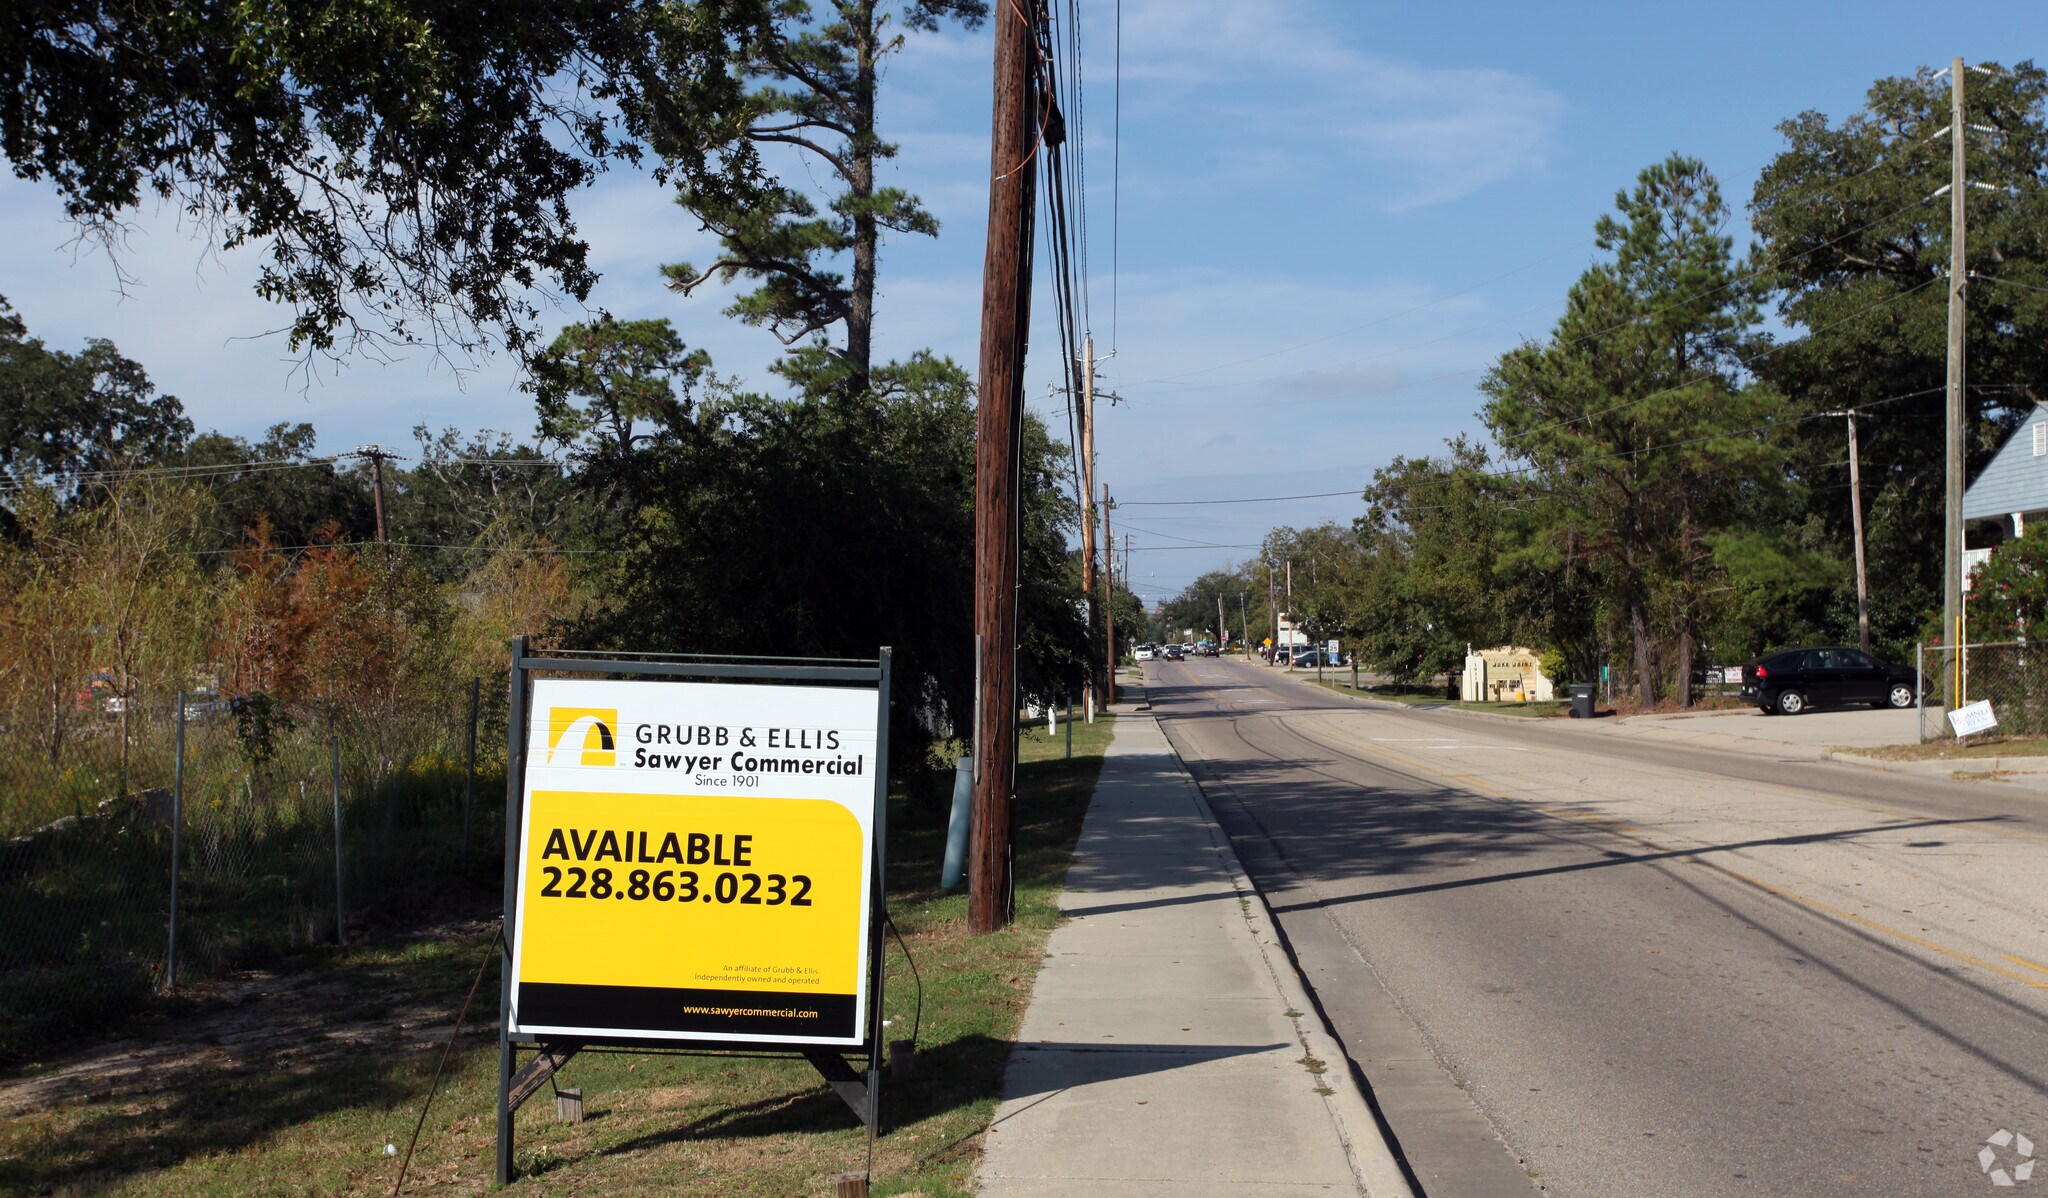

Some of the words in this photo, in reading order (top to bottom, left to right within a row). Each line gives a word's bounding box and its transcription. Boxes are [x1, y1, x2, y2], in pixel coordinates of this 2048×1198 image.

[635, 723, 729, 746] GRUBB
[739, 727, 757, 748] &
[768, 728, 841, 750] ELLIS
[634, 748, 722, 774] Sawyer
[730, 751, 863, 776] Commercial
[695, 773, 728, 787] Since
[732, 774, 759, 788] 1901
[541, 828, 753, 867] AVAILABLE
[540, 865, 812, 907] 228.863.0232
[694, 974, 745, 984] Independently
[747, 975, 772, 983] owned
[773, 976, 787, 984] and
[788, 977, 820, 986] operated
[734, 965, 762, 973] affiliate
[772, 966, 795, 974] Grubb
[683, 1006, 818, 1019] www.sawyercommercial.com
